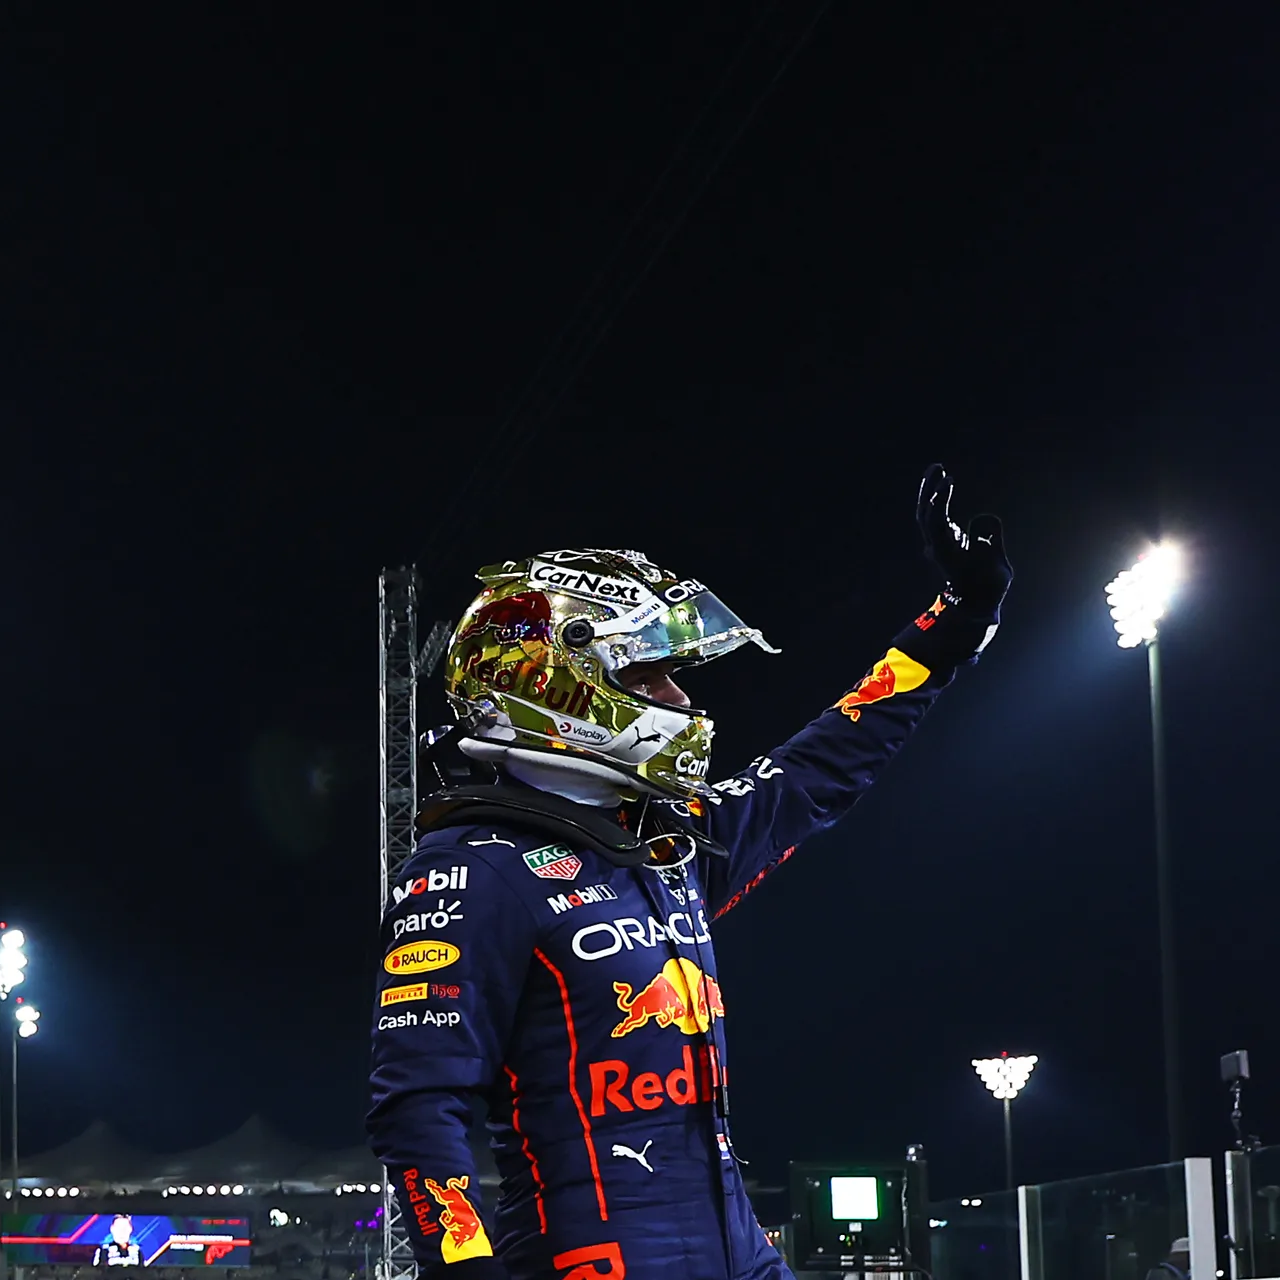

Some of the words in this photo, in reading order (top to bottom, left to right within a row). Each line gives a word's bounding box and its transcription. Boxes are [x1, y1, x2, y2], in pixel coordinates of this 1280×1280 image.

[533, 564, 640, 601] CarNext
[664, 579, 707, 603] ORA
[573, 725, 608, 743] viaplay
[675, 751, 710, 777] CarN
[534, 857, 580, 879] HEUER
[392, 866, 468, 905] Mobil
[547, 885, 599, 915] Mobil
[401, 949, 449, 967] RAUCH
[382, 984, 428, 1005] PIRELLI
[378, 1010, 417, 1031] Cash
[422, 1009, 460, 1029] App
